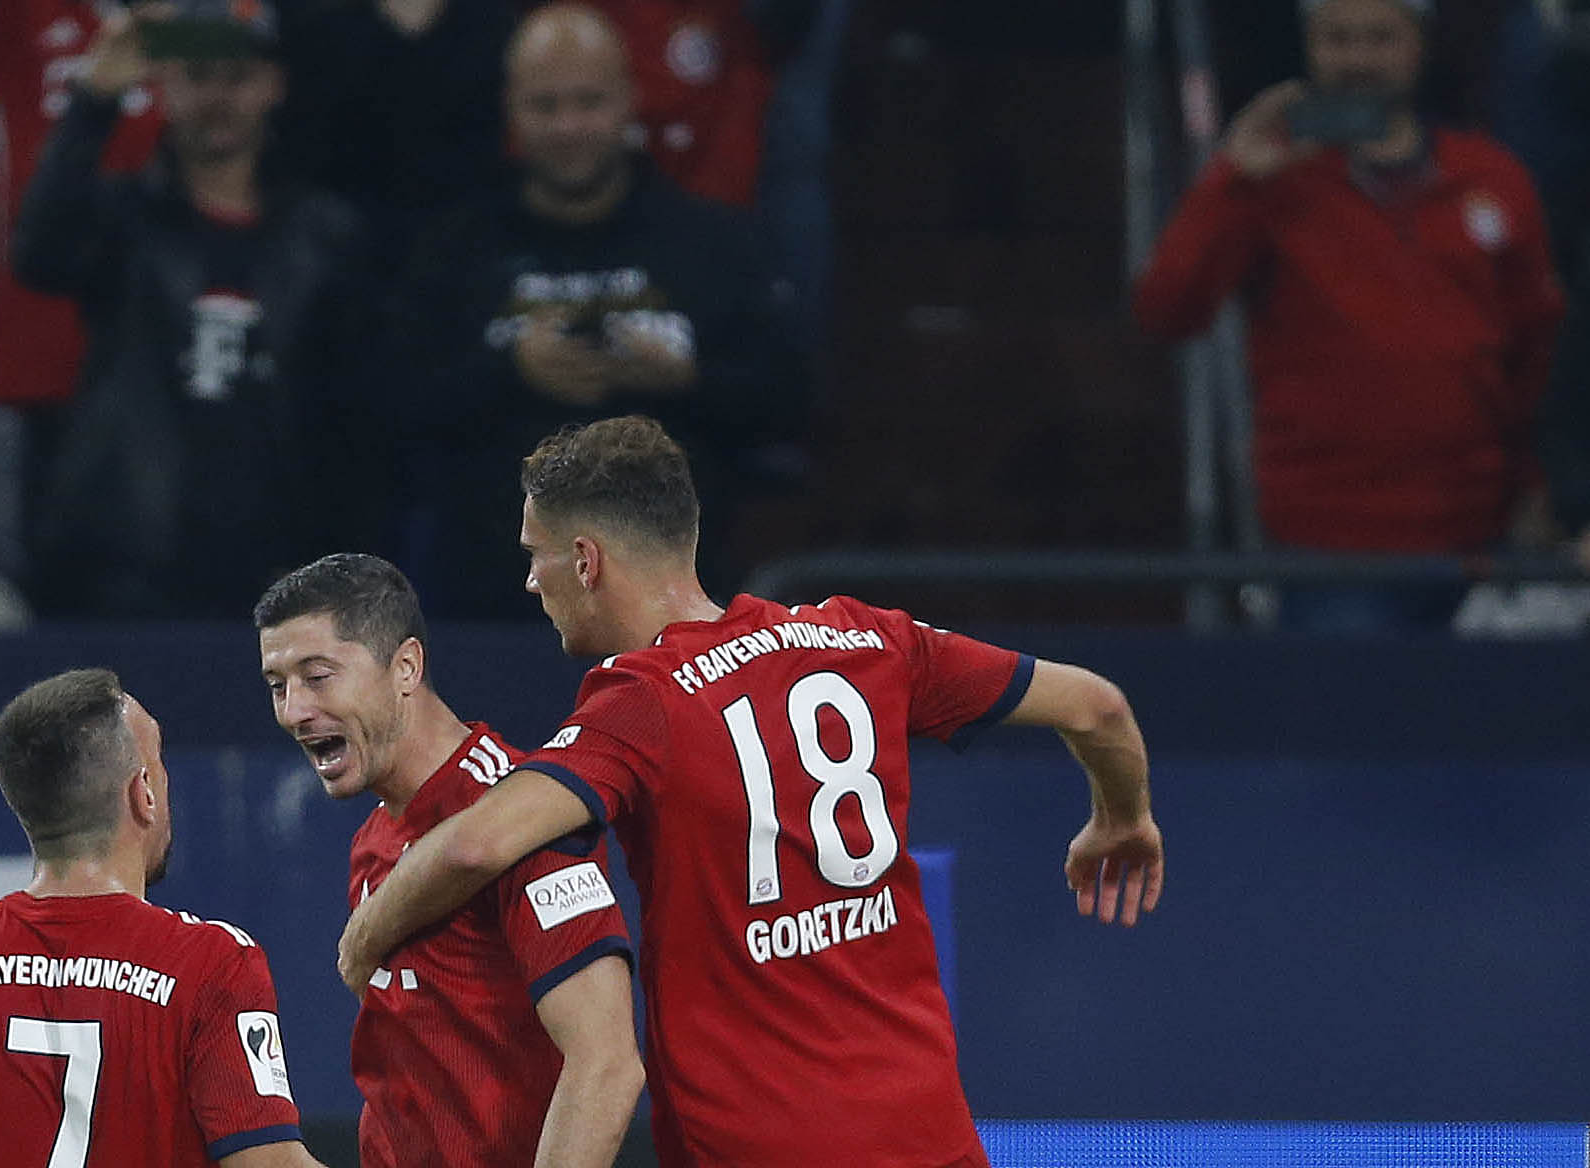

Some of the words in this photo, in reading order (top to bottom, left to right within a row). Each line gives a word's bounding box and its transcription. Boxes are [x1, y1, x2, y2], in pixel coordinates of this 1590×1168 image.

[672, 662, 704, 694] FC
[694, 629, 781, 682] BAYERN
[722, 671, 899, 904] 18
[534, 871, 602, 906] QATAR
[745, 885, 899, 964] GORETZKA
